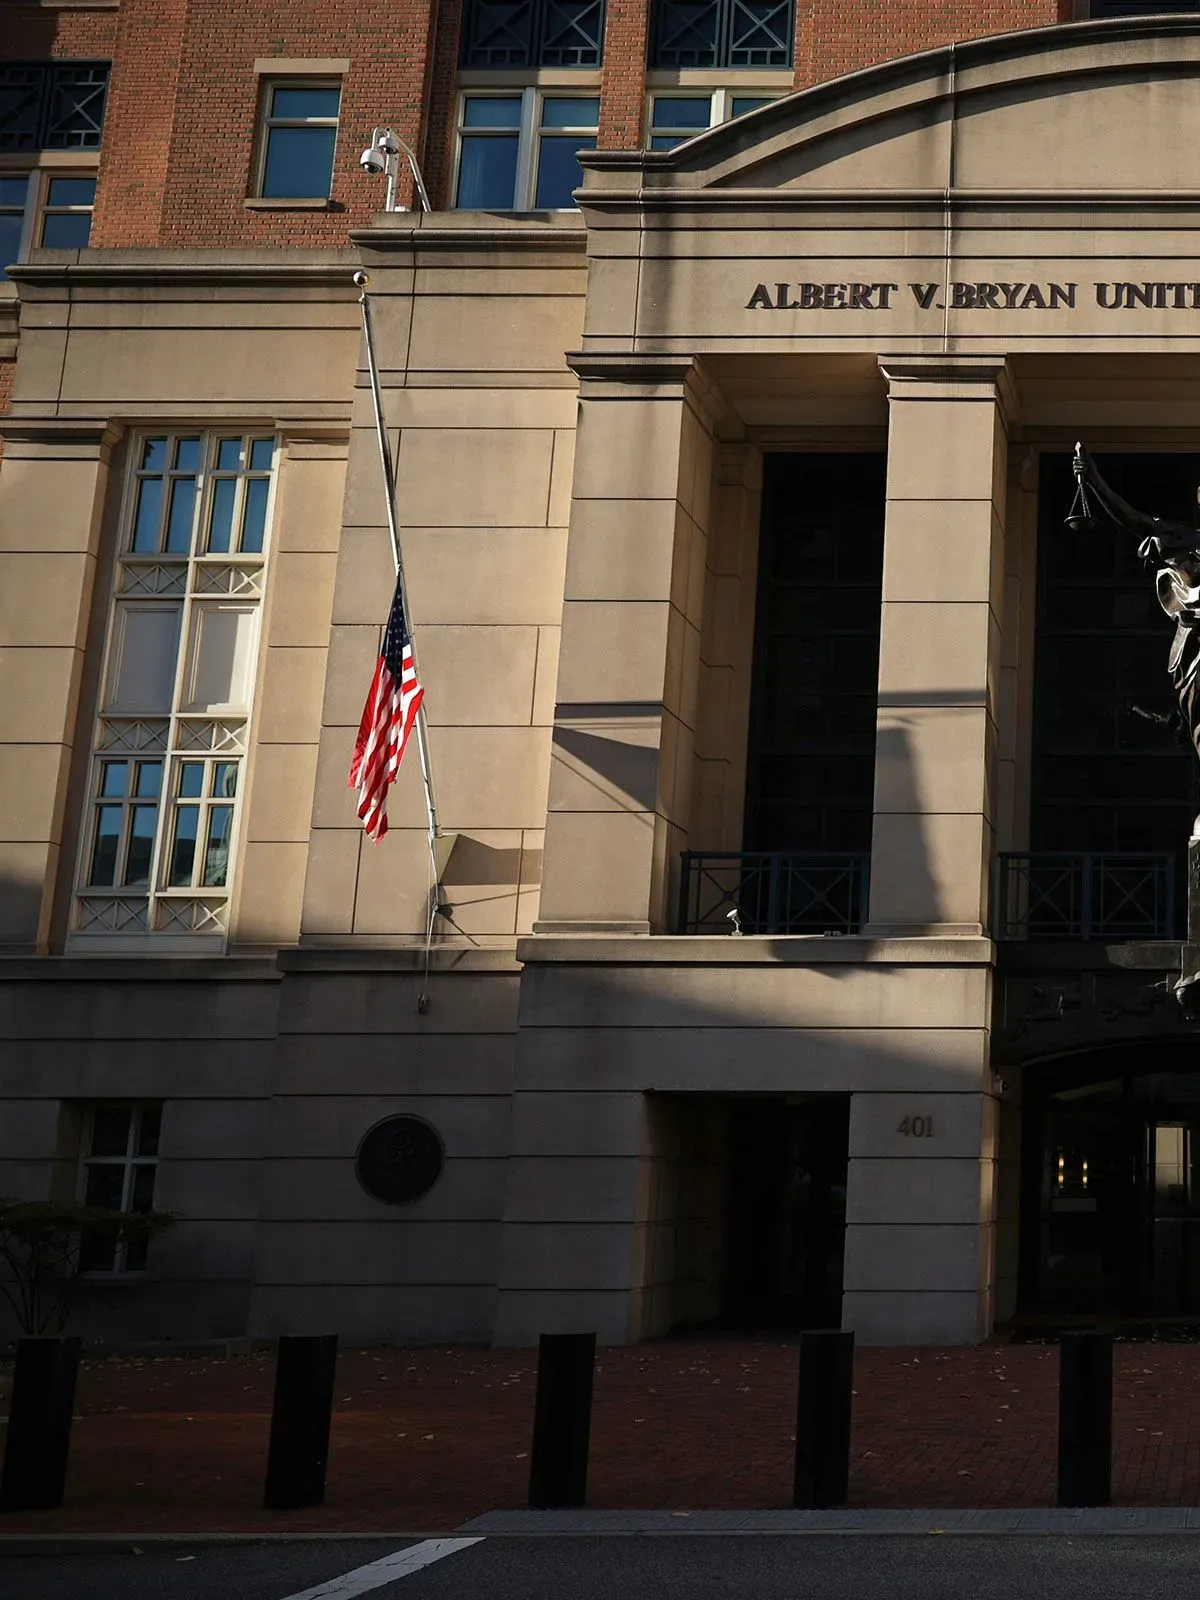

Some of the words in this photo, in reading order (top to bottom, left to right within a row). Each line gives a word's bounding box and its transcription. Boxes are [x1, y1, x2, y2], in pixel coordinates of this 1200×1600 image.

[745, 283, 898, 309] ALBERT
[908, 284, 945, 310] V.
[949, 282, 1077, 309] BRYAN
[897, 1116, 934, 1138] 401
